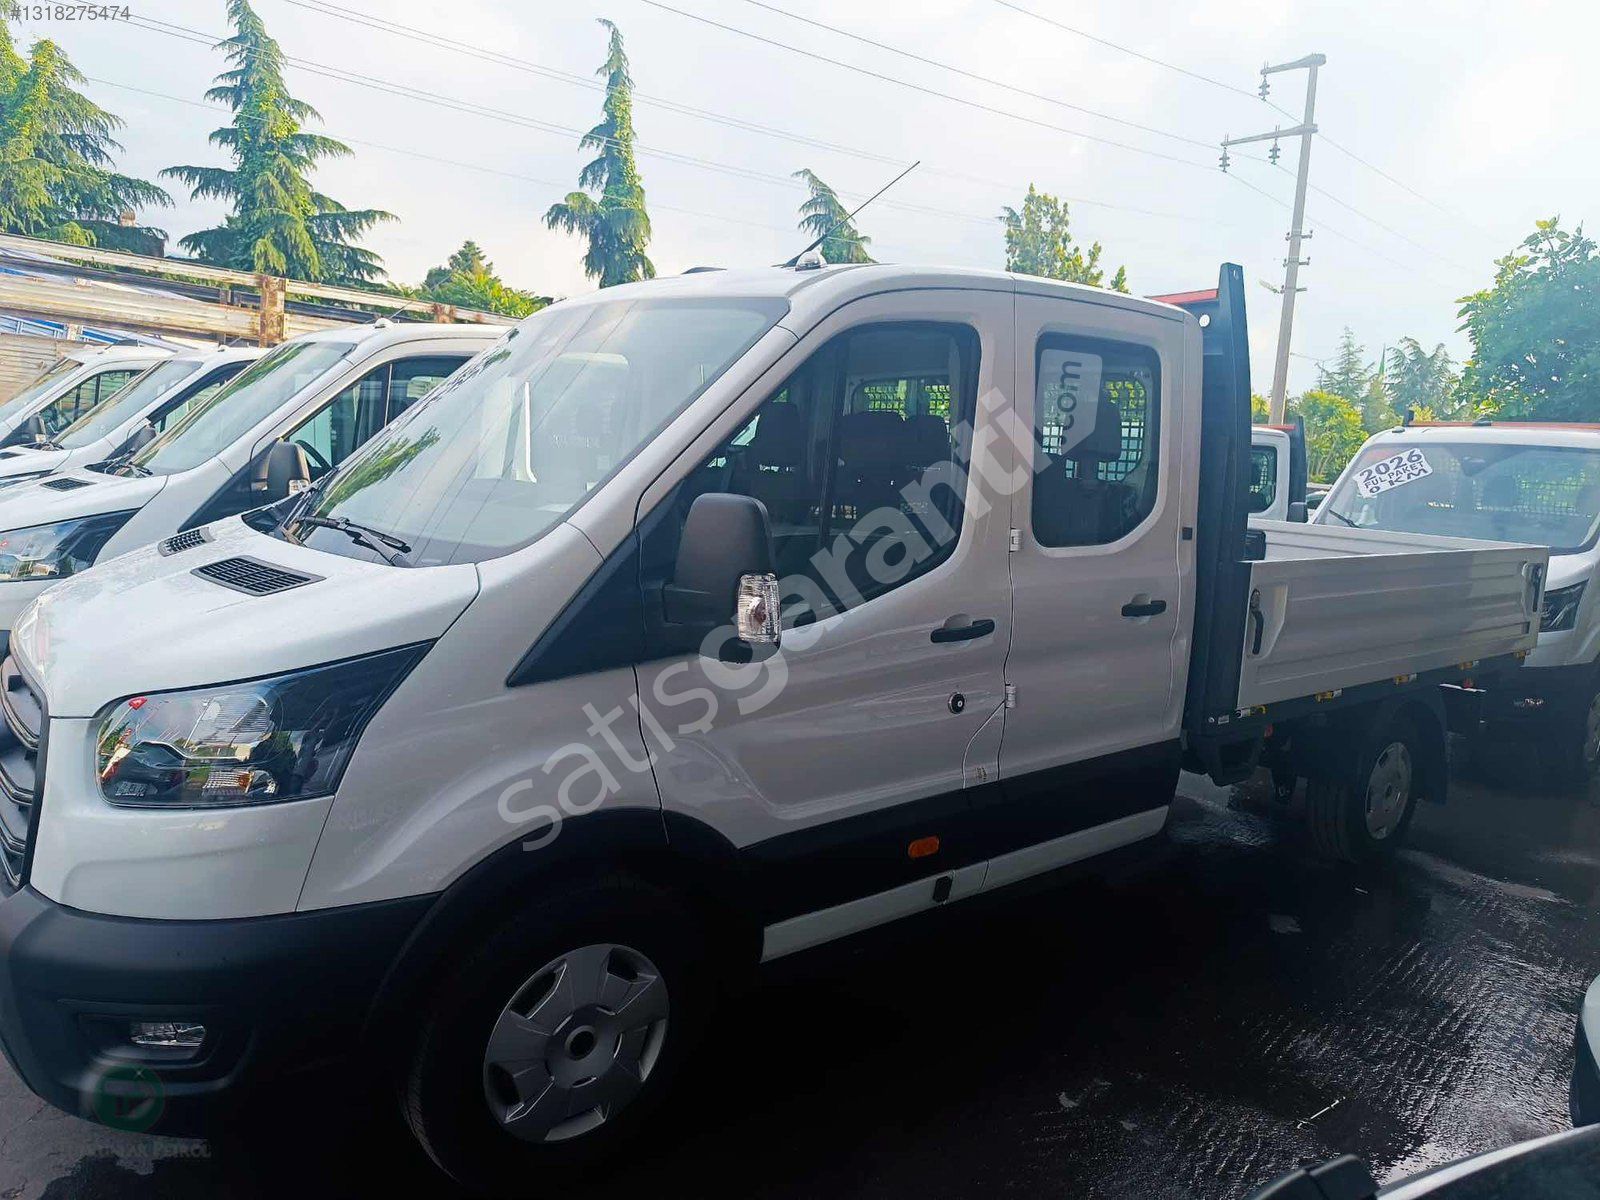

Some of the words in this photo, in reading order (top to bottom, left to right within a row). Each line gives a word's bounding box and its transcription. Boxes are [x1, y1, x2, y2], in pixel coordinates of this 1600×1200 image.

[1360, 450, 1422, 483] 2026
[1364, 476, 1387, 489] FUL
[1387, 461, 1425, 480] PAKET
[1388, 468, 1428, 486] KM
